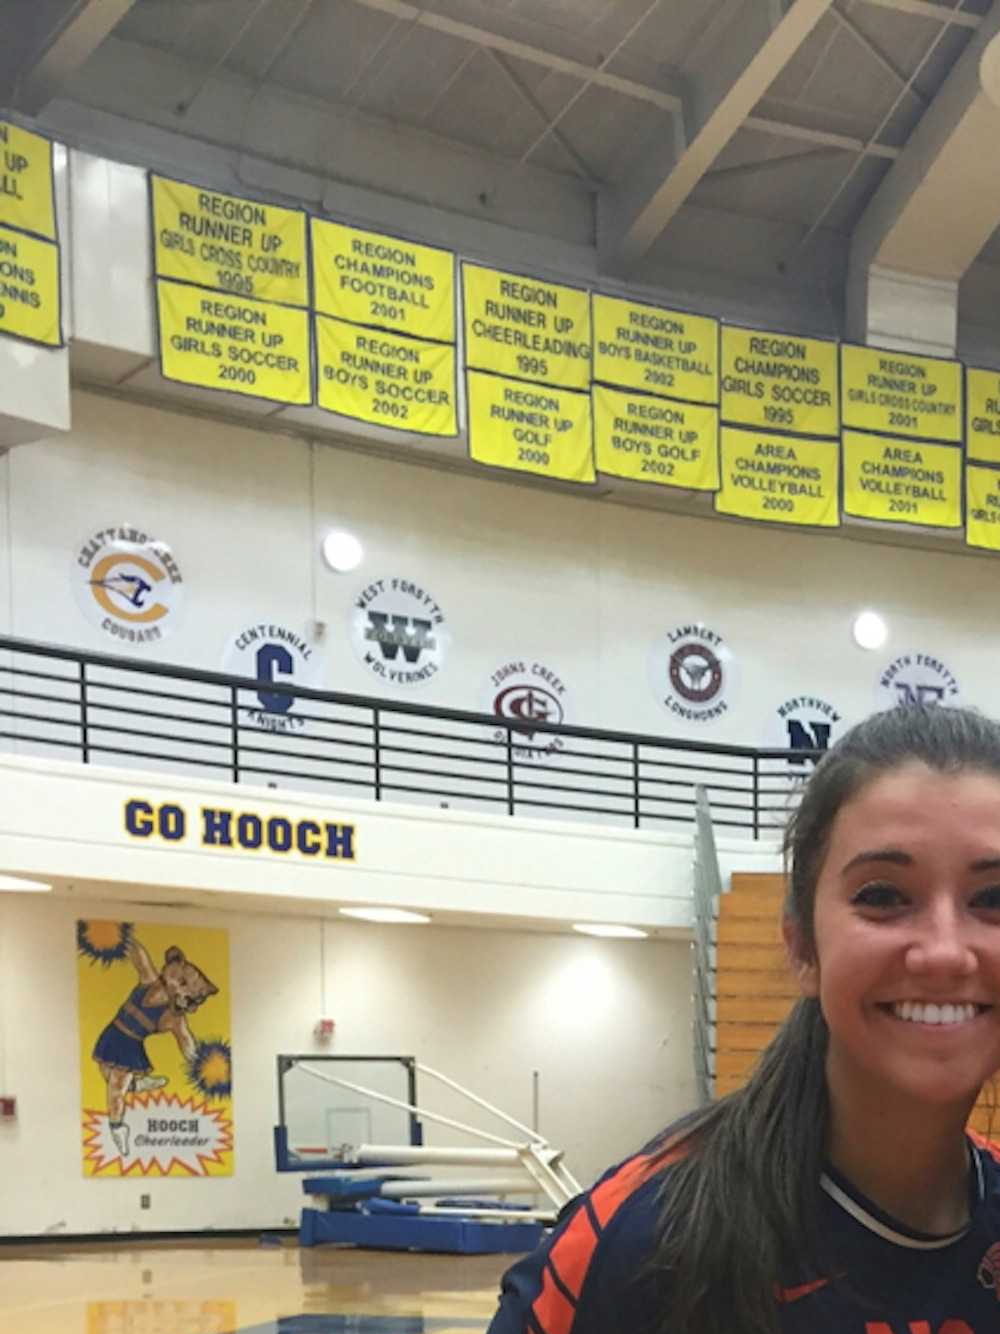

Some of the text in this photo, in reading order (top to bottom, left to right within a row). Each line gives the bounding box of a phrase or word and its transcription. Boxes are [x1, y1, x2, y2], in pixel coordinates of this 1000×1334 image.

[198, 193, 267, 226] REGION
[179, 212, 281, 252] RUNNER UP
[160, 229, 196, 256] GIRLS
[200, 243, 242, 269] CROSS
[352, 239, 416, 266] REGION
[334, 255, 434, 290] CHAMPIONS
[340, 275, 429, 309] FOOTBALL
[500, 280, 557, 307] REGION
[201, 299, 267, 325] REGION
[371, 302, 405, 320] 2001
[485, 300, 573, 333] RUNNER UP
[629, 311, 684, 334] REGION
[186, 317, 284, 348] RUNNER UP
[472, 319, 590, 360] CHEERLEADING
[616, 327, 697, 354] RUNNER UP
[170, 334, 299, 372] GIRLS SOCCER
[356, 337, 419, 363] REGION
[599, 342, 712, 375] BOYS BASKETBALL
[750, 337, 806, 360] REGION
[219, 364, 256, 384] 2000
[341, 351, 433, 384] RUNNER UP
[517, 355, 547, 376] 1995
[734, 357, 820, 384] CHAMPIONS
[879, 359, 926, 378] REGION
[324, 365, 449, 405] BOYS SOCCER
[722, 376, 831, 406] GIRLS SOCCER
[868, 374, 937, 396] RUNNER UP
[372, 398, 408, 419] 2002
[504, 389, 560, 412] REGION
[490, 404, 573, 432] RUNNER UP
[627, 403, 685, 425] REGION
[513, 428, 551, 446] GOLF
[613, 417, 698, 445] RUNNER UP
[612, 436, 701, 461] BOYS GOLF
[755, 443, 797, 461] AREA
[883, 447, 922, 464] AREA
[642, 460, 674, 476] 2002
[735, 458, 821, 481] CHAMPIONS
[861, 461, 944, 484] CHAMPIONS
[731, 473, 824, 498] VOLLEYBALL
[859, 478, 947, 501] VOLLEYBALL
[235, 625, 312, 661] CENTENNIAL
[668, 625, 723, 646] LAMBERT
[365, 651, 438, 683] WOLVERINES
[491, 662, 565, 695] JOHNS CREEK
[880, 655, 958, 695] NORTH FORSYTH
[664, 695, 728, 721] LONGHORNS
[778, 696, 840, 722] NORTHVIEW
[125, 799, 355, 860] GO HOOCH
[148, 1118, 199, 1132] HOOCH
[134, 1134, 209, 1146] Cheerleader
